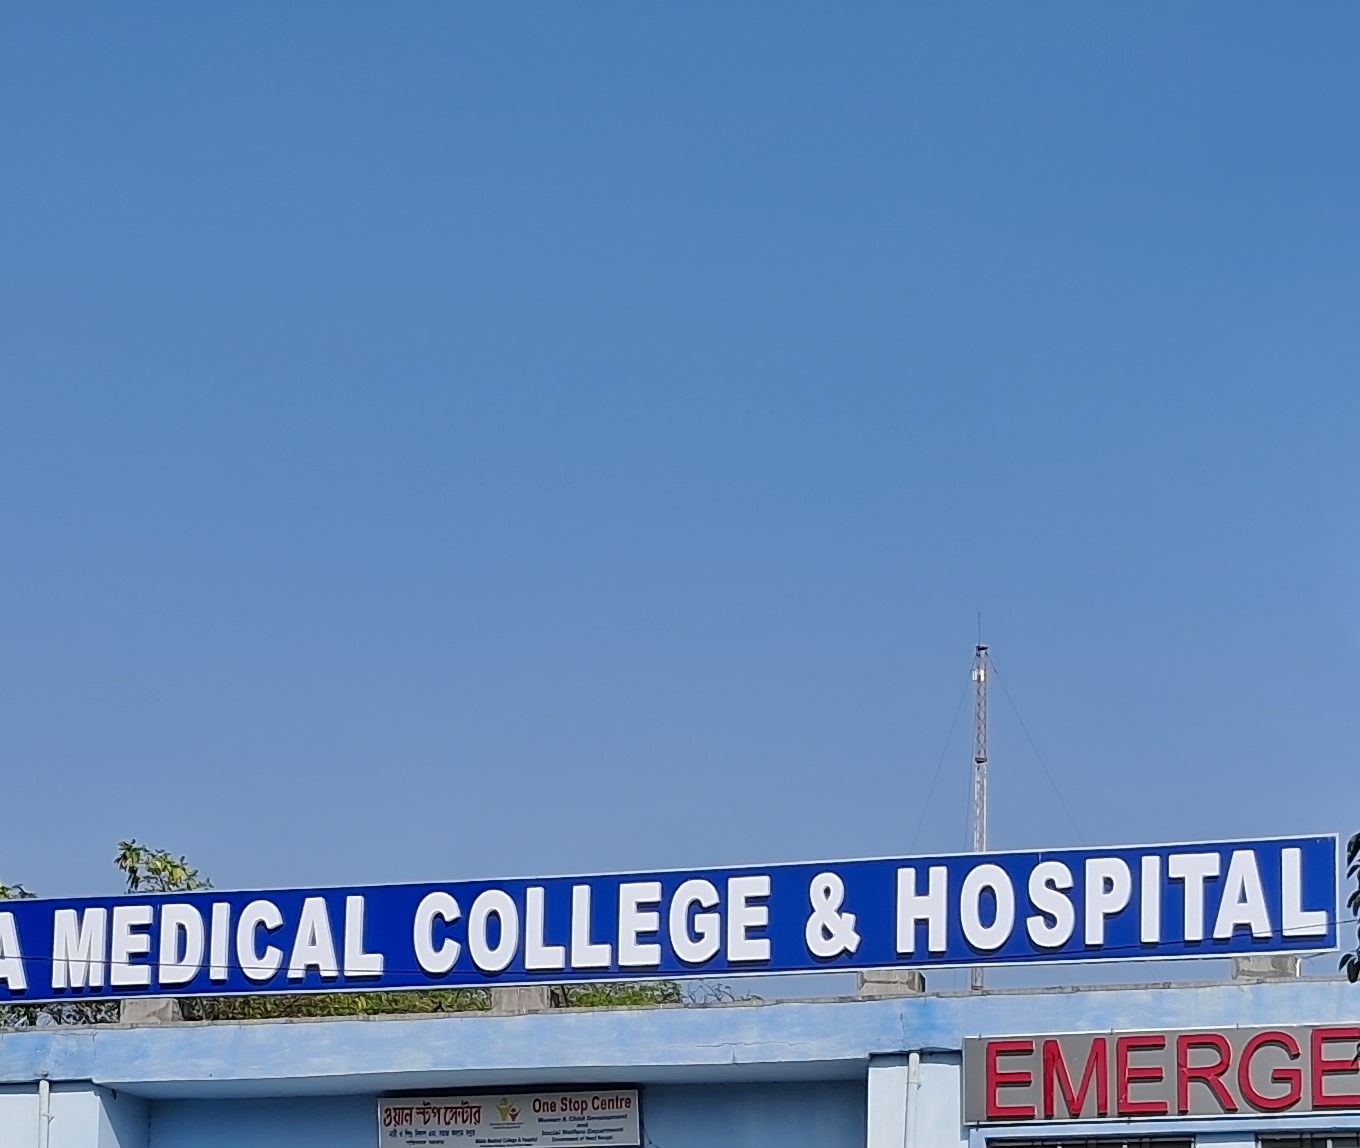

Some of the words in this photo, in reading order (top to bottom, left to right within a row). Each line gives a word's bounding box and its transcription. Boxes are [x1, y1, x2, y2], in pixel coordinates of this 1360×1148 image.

[51, 895, 384, 990] MEDICAL
[413, 874, 772, 974] COLLEGE
[805, 872, 862, 958] &
[896, 847, 1329, 954] HOSPITAL
[532, 1098, 557, 1113] One
[560, 1097, 588, 1115] Stop
[592, 1095, 632, 1110] Centre
